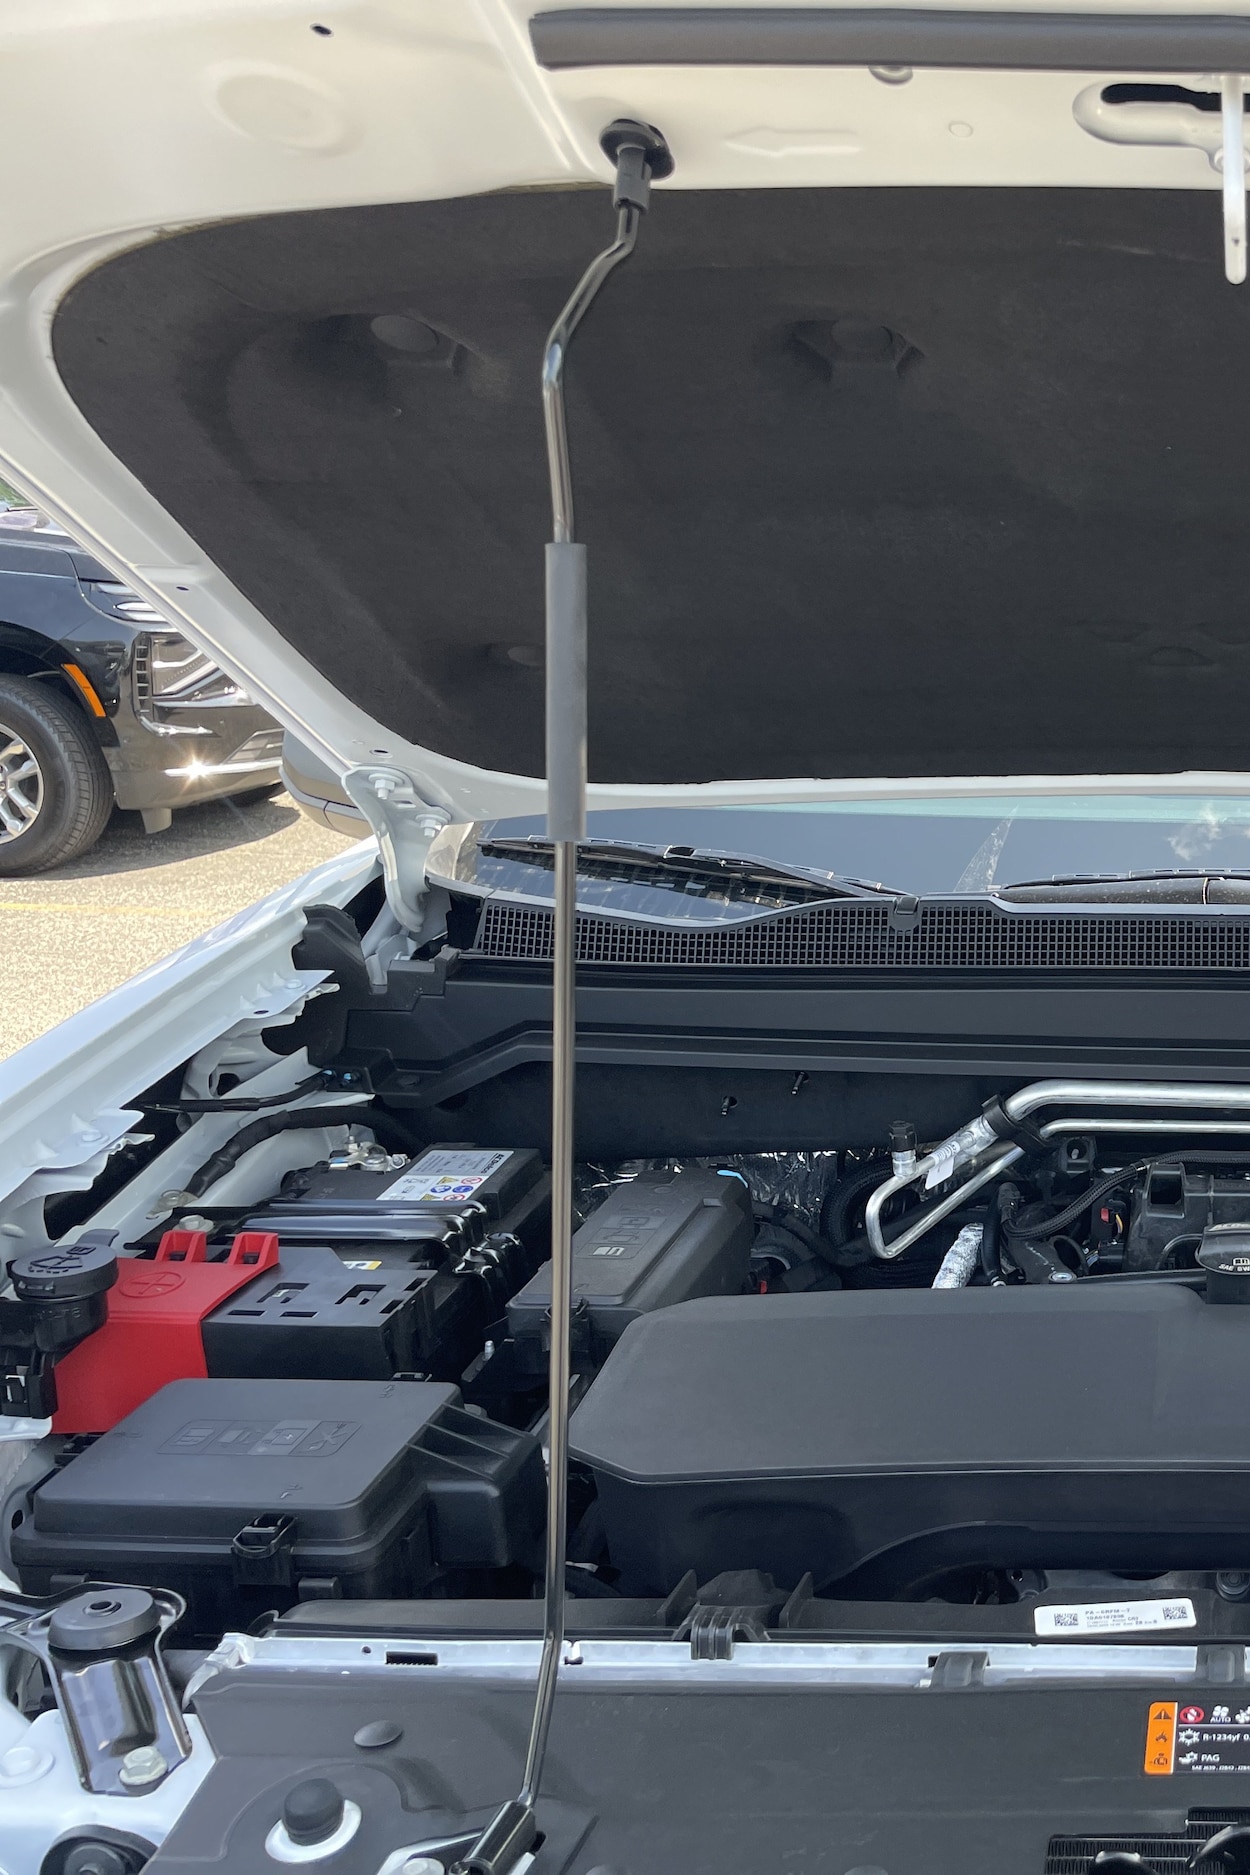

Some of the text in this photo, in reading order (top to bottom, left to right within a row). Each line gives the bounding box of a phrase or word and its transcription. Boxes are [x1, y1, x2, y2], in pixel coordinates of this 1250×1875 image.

[1218, 1263, 1234, 1271] SAE
[1202, 1733, 1241, 1743] R-1234yf
[1201, 1753, 1220, 1762] PAG
